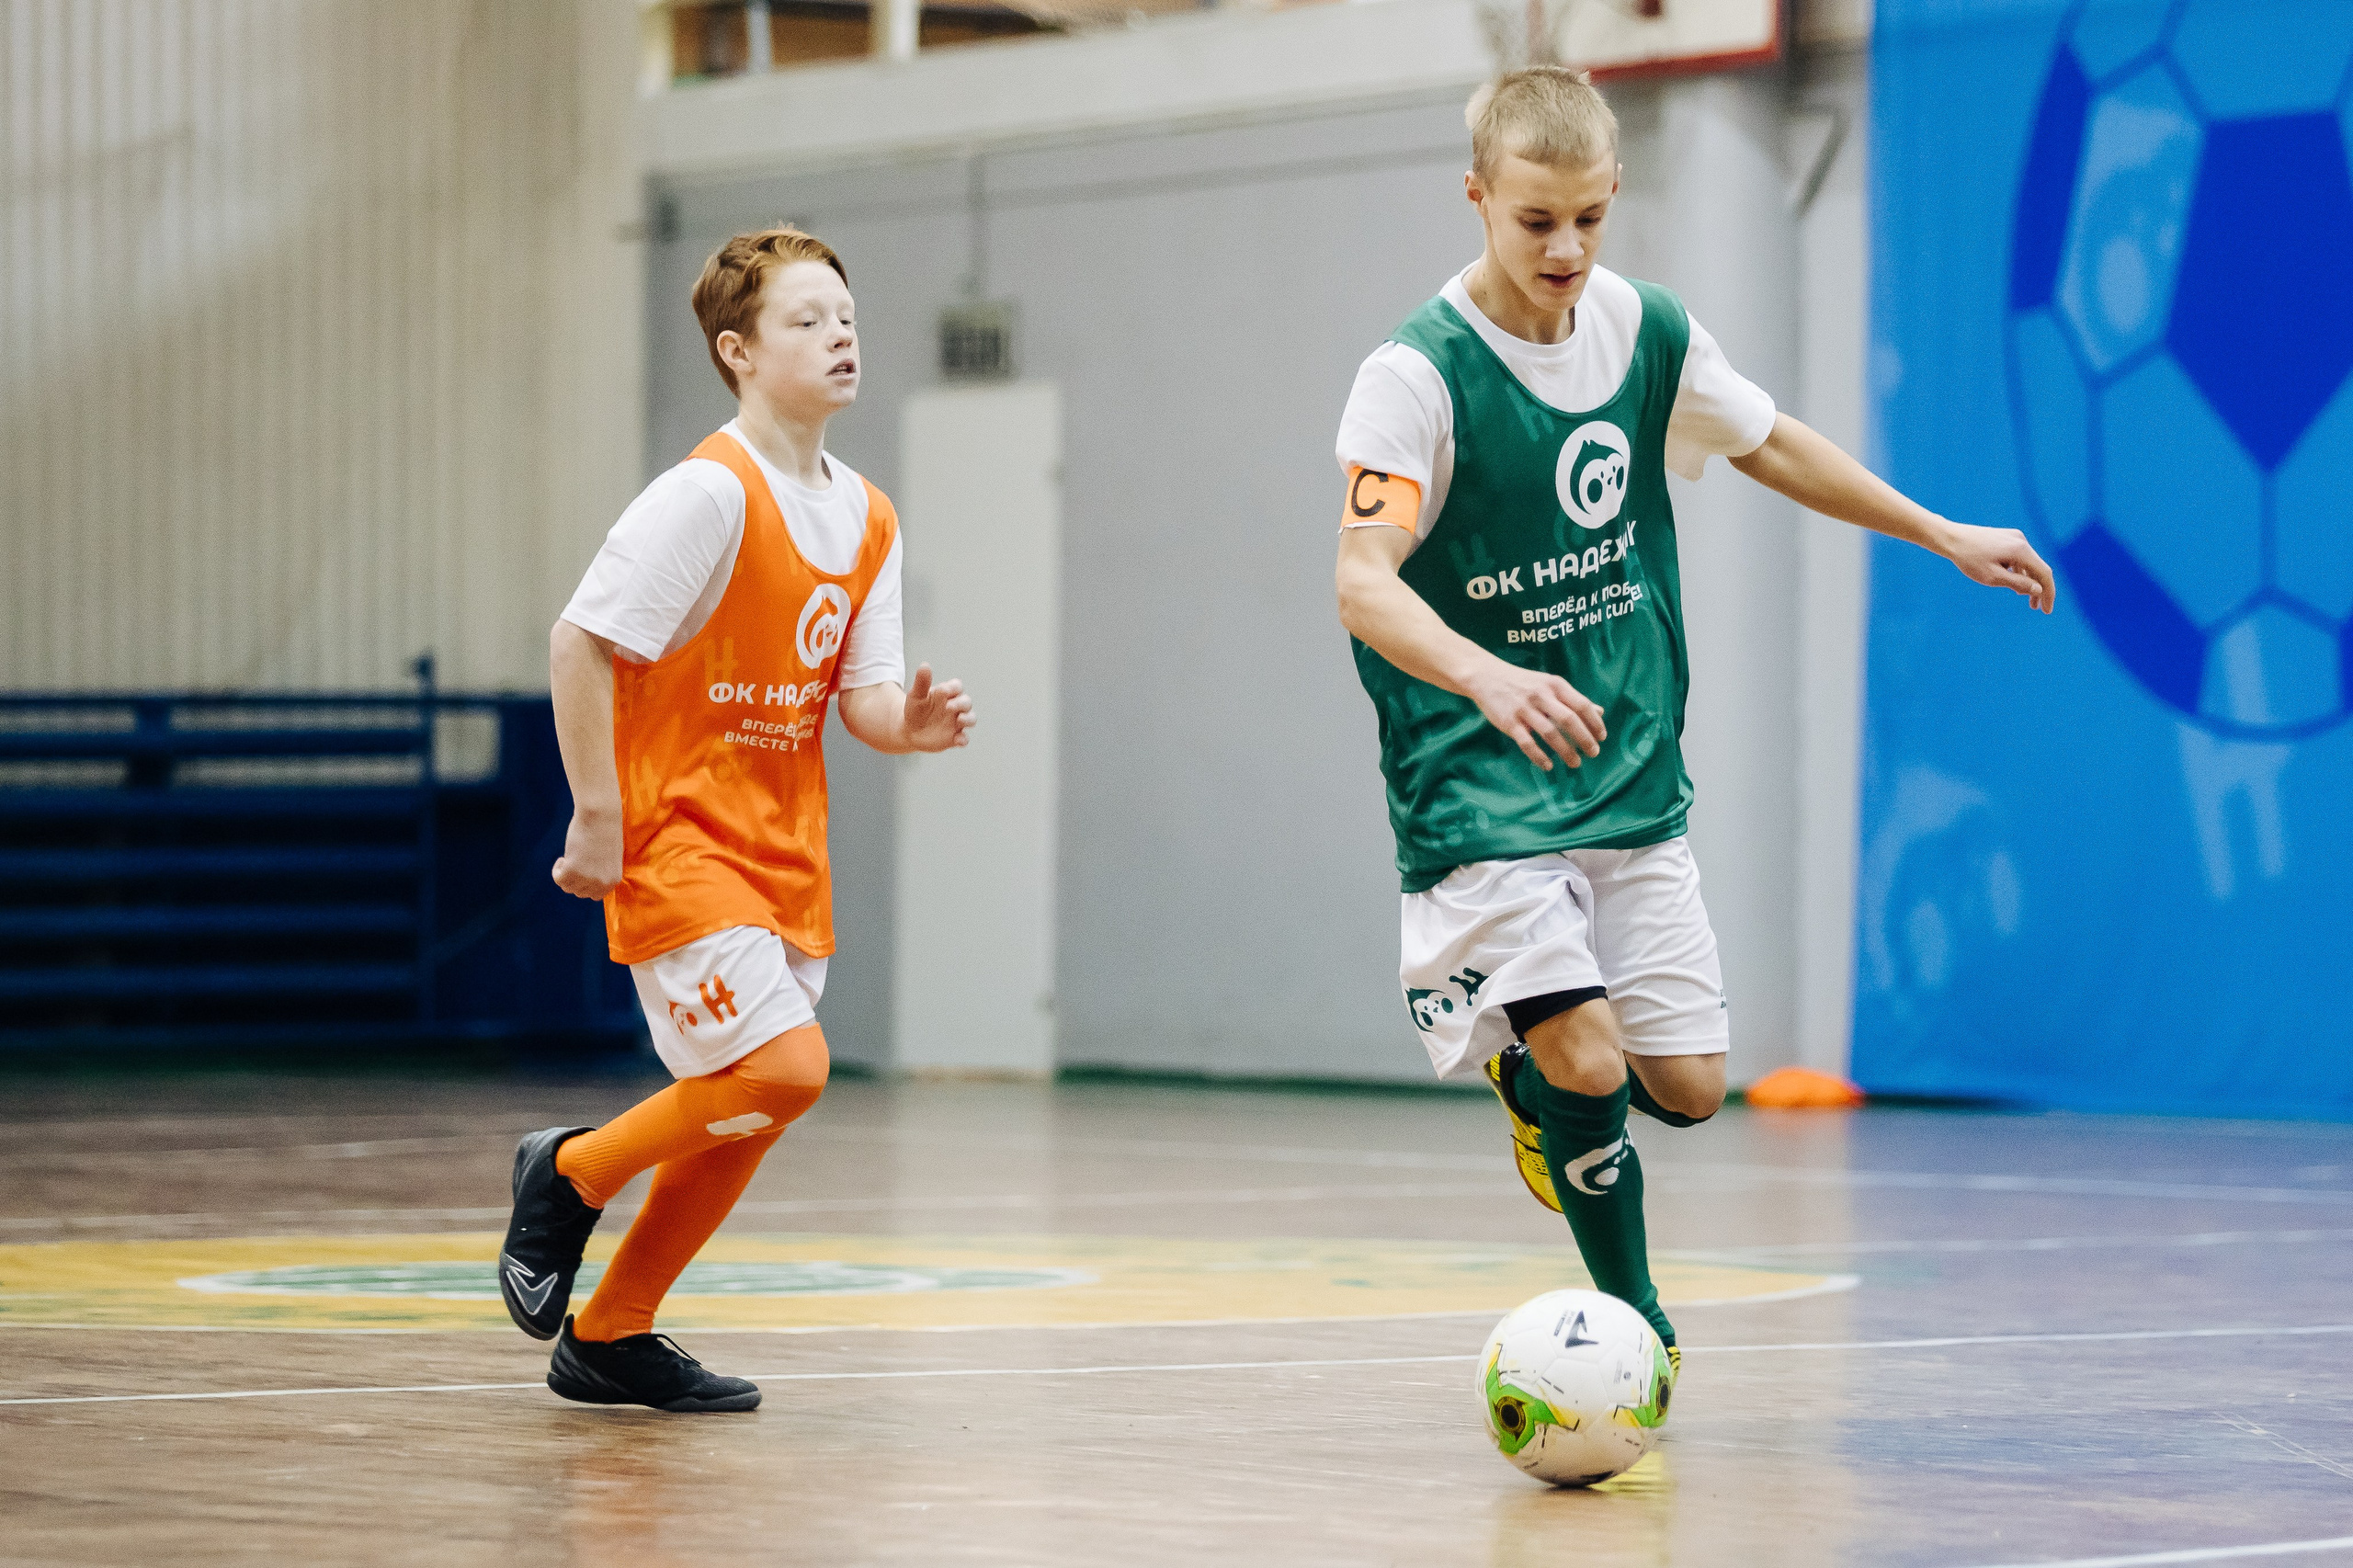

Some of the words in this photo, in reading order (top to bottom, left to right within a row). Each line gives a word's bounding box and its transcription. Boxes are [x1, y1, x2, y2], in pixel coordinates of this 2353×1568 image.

[1351, 468, 1389, 517] C
[1466, 566, 1525, 600] ФК
[1521, 596, 1586, 624] ВПЕРЁД
[1590, 590, 1598, 607] К
[1506, 619, 1574, 643] ВМЕСТЕ
[1579, 608, 1602, 631] МЫ
[708, 682, 756, 704] ФК
[723, 732, 790, 751] ВМЕСТЕ
